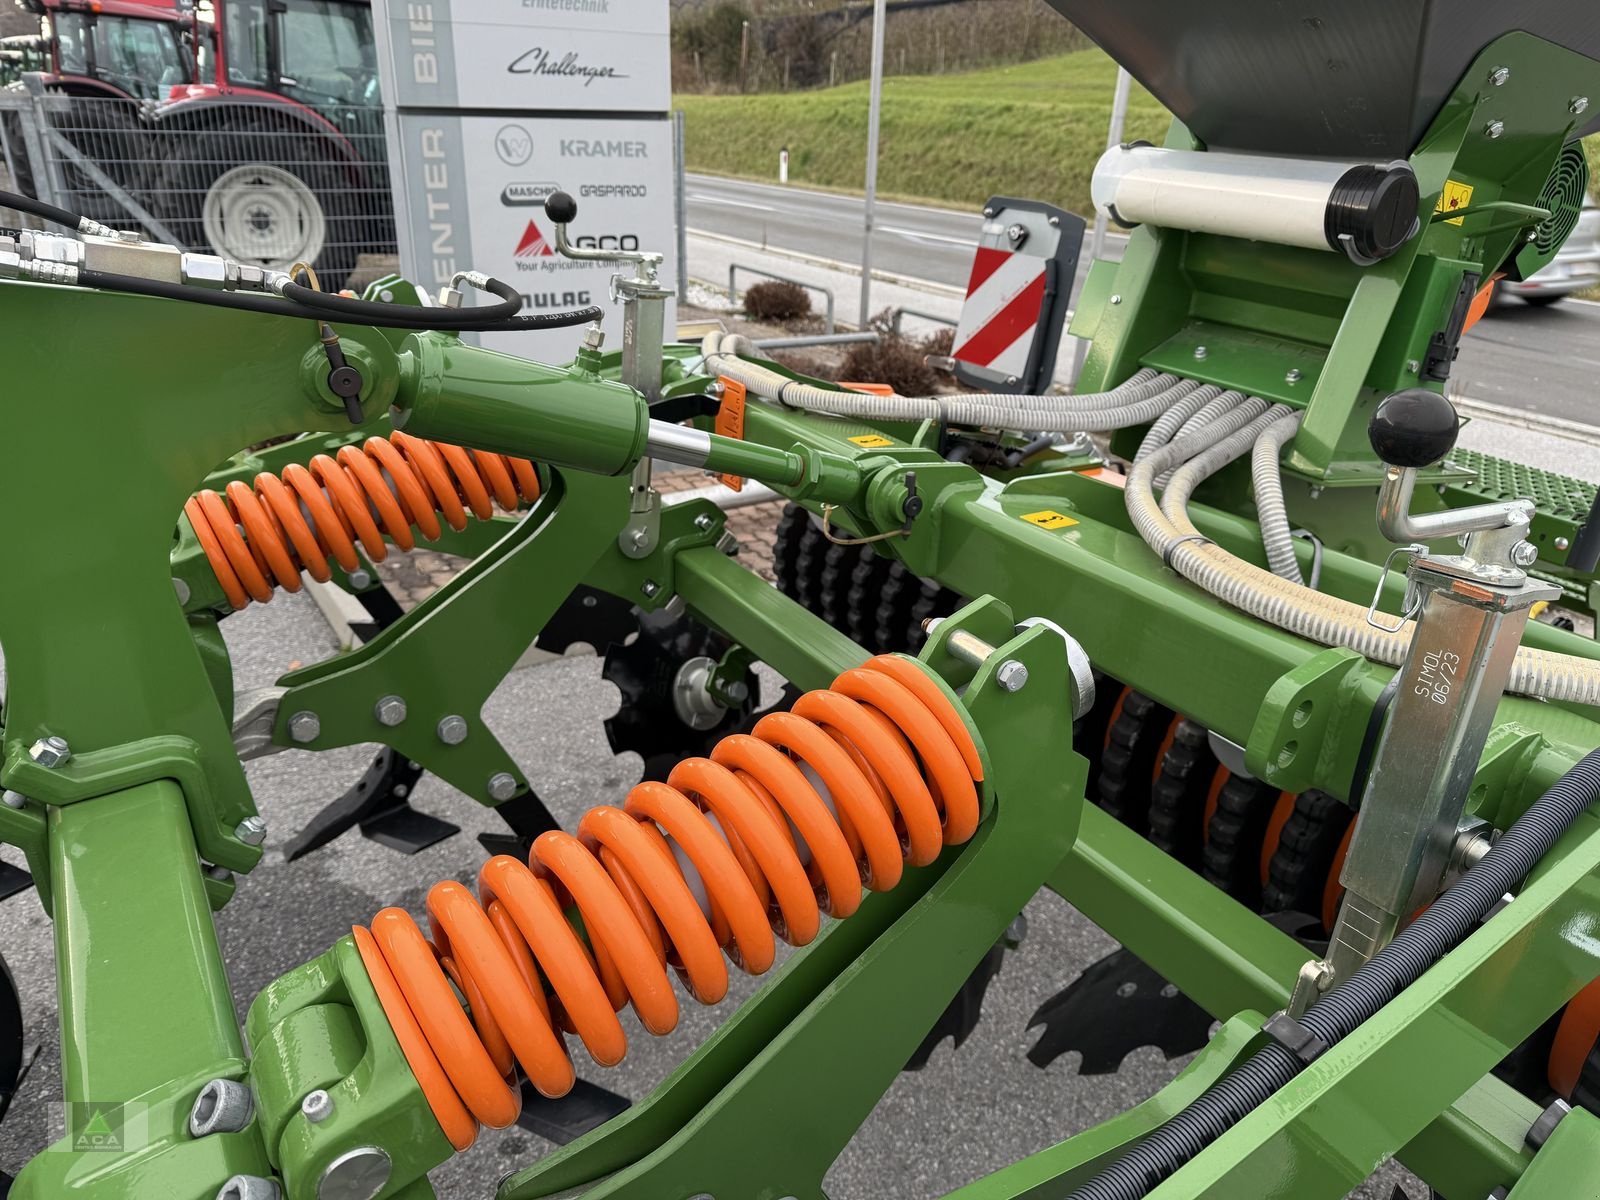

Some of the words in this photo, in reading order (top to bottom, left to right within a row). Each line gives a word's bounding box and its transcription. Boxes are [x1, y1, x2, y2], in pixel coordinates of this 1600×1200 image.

[507, 47, 631, 87] Challenger
[560, 139, 648, 159] KRAMER
[580, 184, 647, 198] GASPARDO
[516, 261, 538, 272] Your
[541, 260, 594, 273] Agriculture
[1414, 650, 1443, 698] SIMOL
[1431, 651, 1460, 705] 06/23
